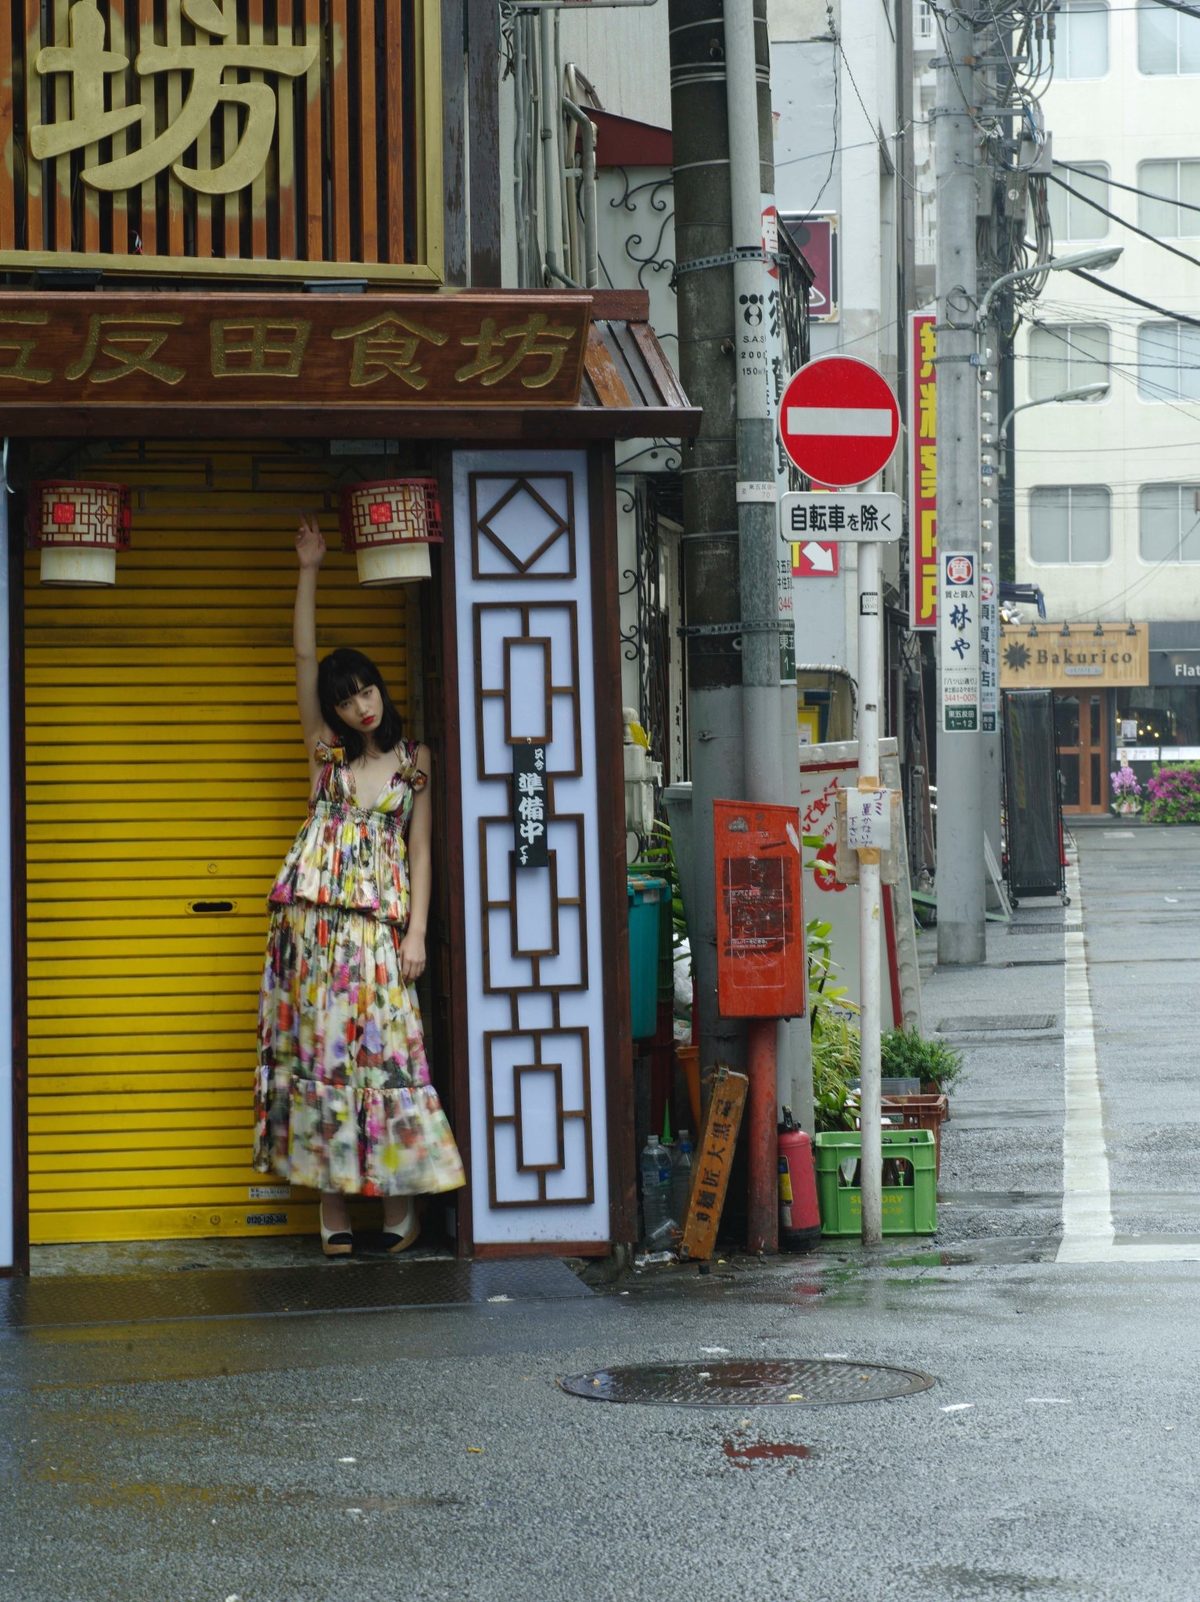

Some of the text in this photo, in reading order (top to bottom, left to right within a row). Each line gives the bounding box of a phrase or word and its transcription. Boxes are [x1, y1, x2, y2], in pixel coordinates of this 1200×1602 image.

[30, 0, 320, 193] 坊
[791, 504, 892, 532] 自転車を除く
[1037, 648, 1133, 664] Bakurico
[950, 720, 973, 728] 1-12
[518, 772, 545, 845] 準備中
[873, 790, 887, 816] ゴミ
